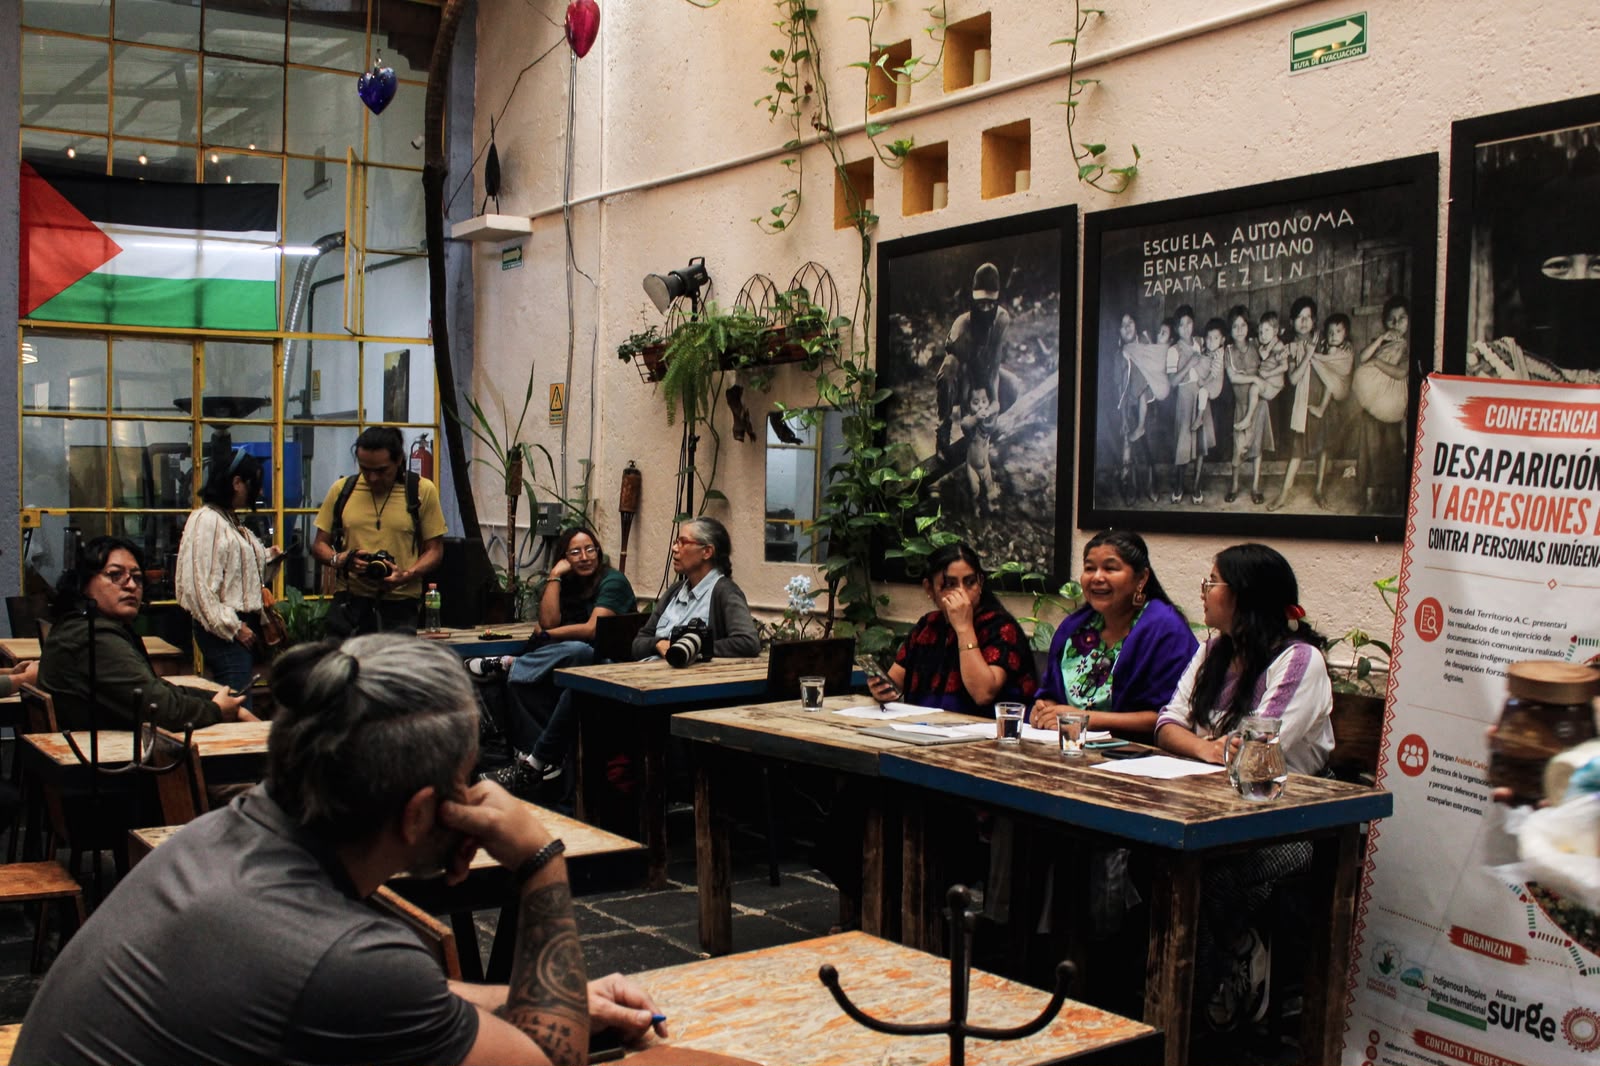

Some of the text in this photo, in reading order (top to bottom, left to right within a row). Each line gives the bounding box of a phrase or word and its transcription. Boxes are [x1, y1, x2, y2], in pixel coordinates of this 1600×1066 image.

[1294, 47, 1363, 70] RUTA DE EVACUACION
[1144, 232, 1214, 256] ESCUELA
[1485, 404, 1598, 434] CONFERENCIA
[1432, 483, 1442, 519] Y
[1444, 485, 1592, 536] AGRESIONES
[1428, 527, 1469, 553] CONTRA
[1472, 533, 1546, 563] PERSONAS
[1448, 605, 1463, 615] Voces
[1464, 608, 1475, 616] del
[1477, 609, 1512, 623] Territorio
[1455, 622, 1487, 632] resultados
[1512, 630, 1542, 641] ejercicio
[1543, 634, 1551, 642] de
[1446, 633, 1565, 658] documentación comunitaria realizado
[1455, 649, 1479, 658] activistas
[1432, 749, 1454, 762] Participan
[1431, 765, 1451, 776] directora
[1432, 781, 1453, 792] personas
[1479, 794, 1487, 802] que
[1463, 932, 1512, 959] ORGANIZAN
[1433, 974, 1486, 1001] Indigenous Peoples
[1496, 989, 1516, 1003] Alianza
[1431, 989, 1486, 1015] Rights International
[1487, 1000, 1556, 1042] surge
[1425, 1035, 1464, 1057] CONTACTO
[1466, 1049, 1471, 1061] Y
